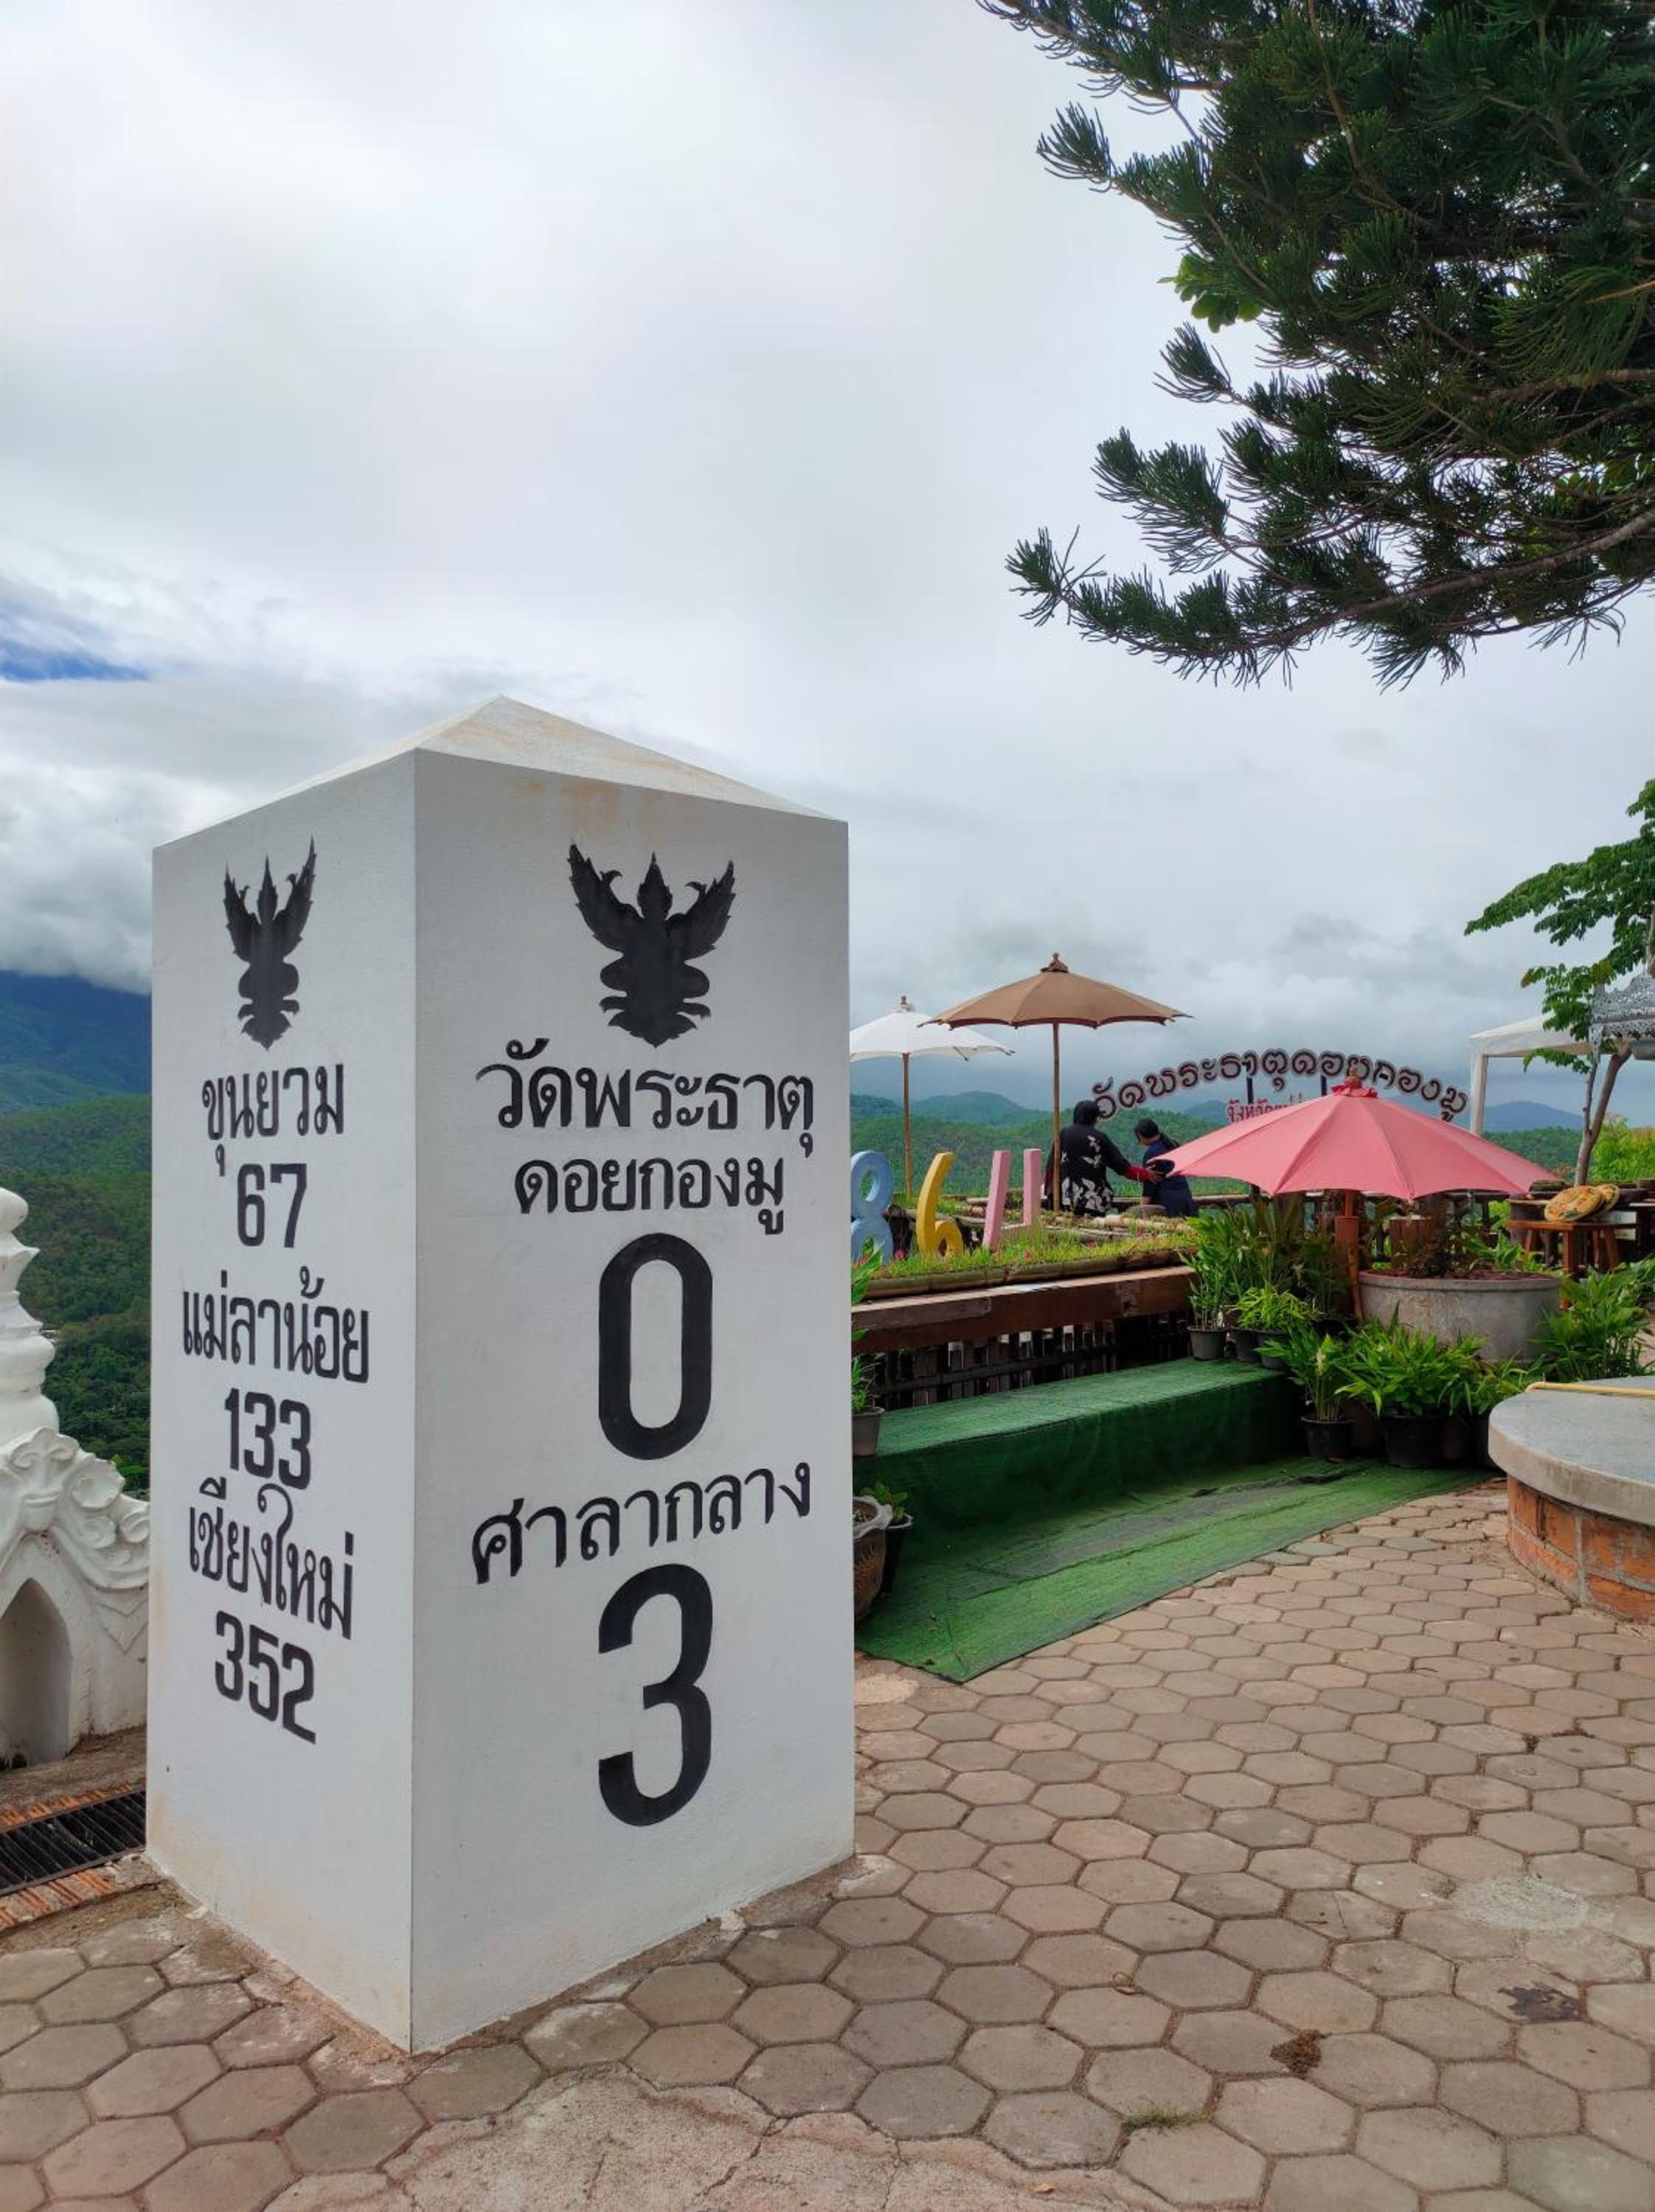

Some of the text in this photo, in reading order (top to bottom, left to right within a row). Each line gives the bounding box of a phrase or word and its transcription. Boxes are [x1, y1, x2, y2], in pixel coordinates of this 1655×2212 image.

[201, 1062, 344, 1178] ขุนยวม
[474, 1037, 814, 1160] วัดพระธาตุ
[237, 1163, 308, 1248] 67
[514, 1157, 785, 1236] ดอยกองมู
[182, 1266, 369, 1384] แม่ลาน้อย
[598, 1232, 713, 1461] 0
[224, 1387, 310, 1490] 133
[189, 1476, 353, 1641] เชียงใหม่
[471, 1461, 811, 1586] ศาลากลาง
[215, 1610, 317, 1745] 352
[598, 1563, 713, 1827] 3
